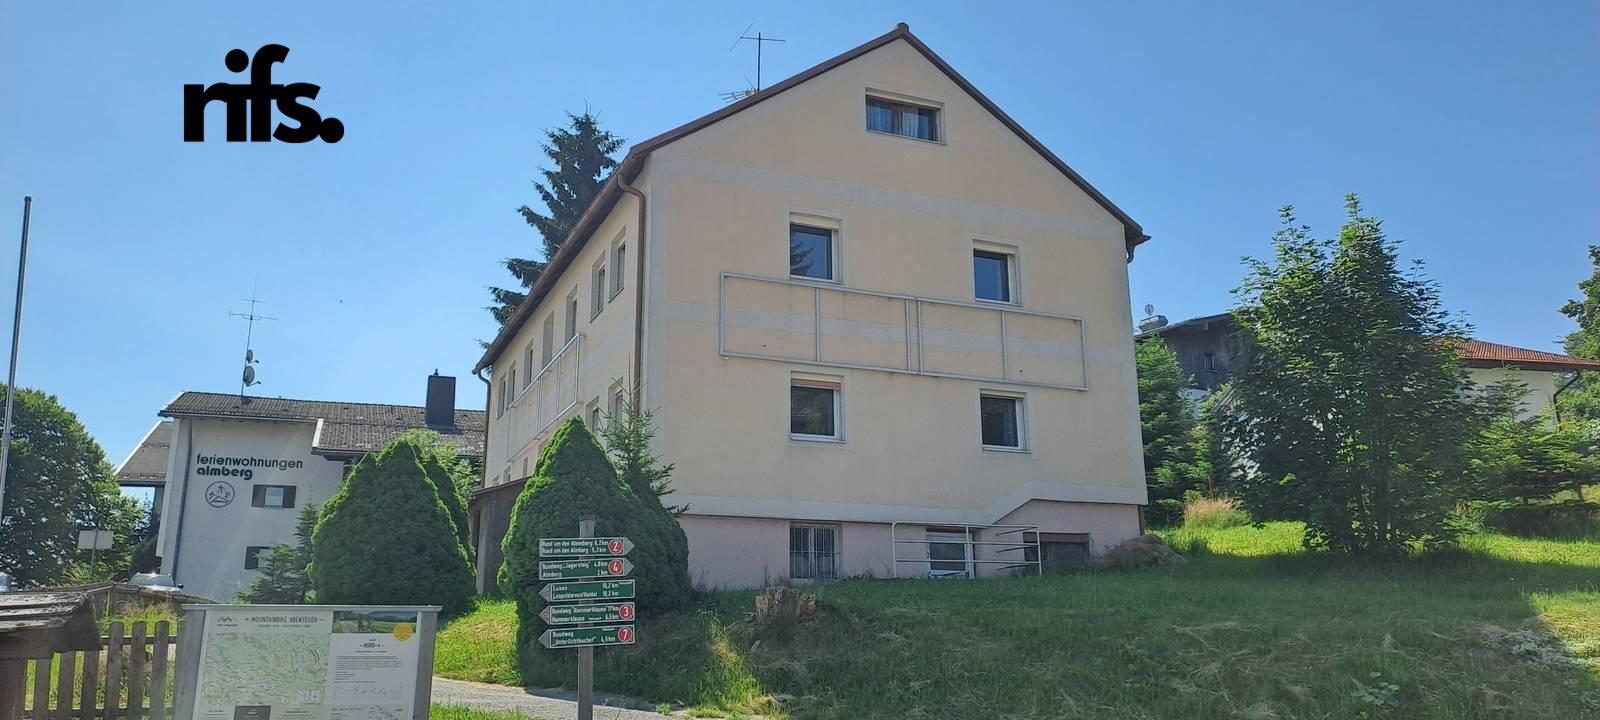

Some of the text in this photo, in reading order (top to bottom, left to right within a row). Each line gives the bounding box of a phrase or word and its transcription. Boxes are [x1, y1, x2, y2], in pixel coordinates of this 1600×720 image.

[196, 453, 303, 471] ferienwohnungen
[196, 466, 253, 480] almberg
[613, 541, 619, 552] 2
[613, 560, 619, 572] 4
[623, 606, 629, 617] 3
[289, 615, 318, 624] ABENTEUER
[623, 629, 629, 640] 7
